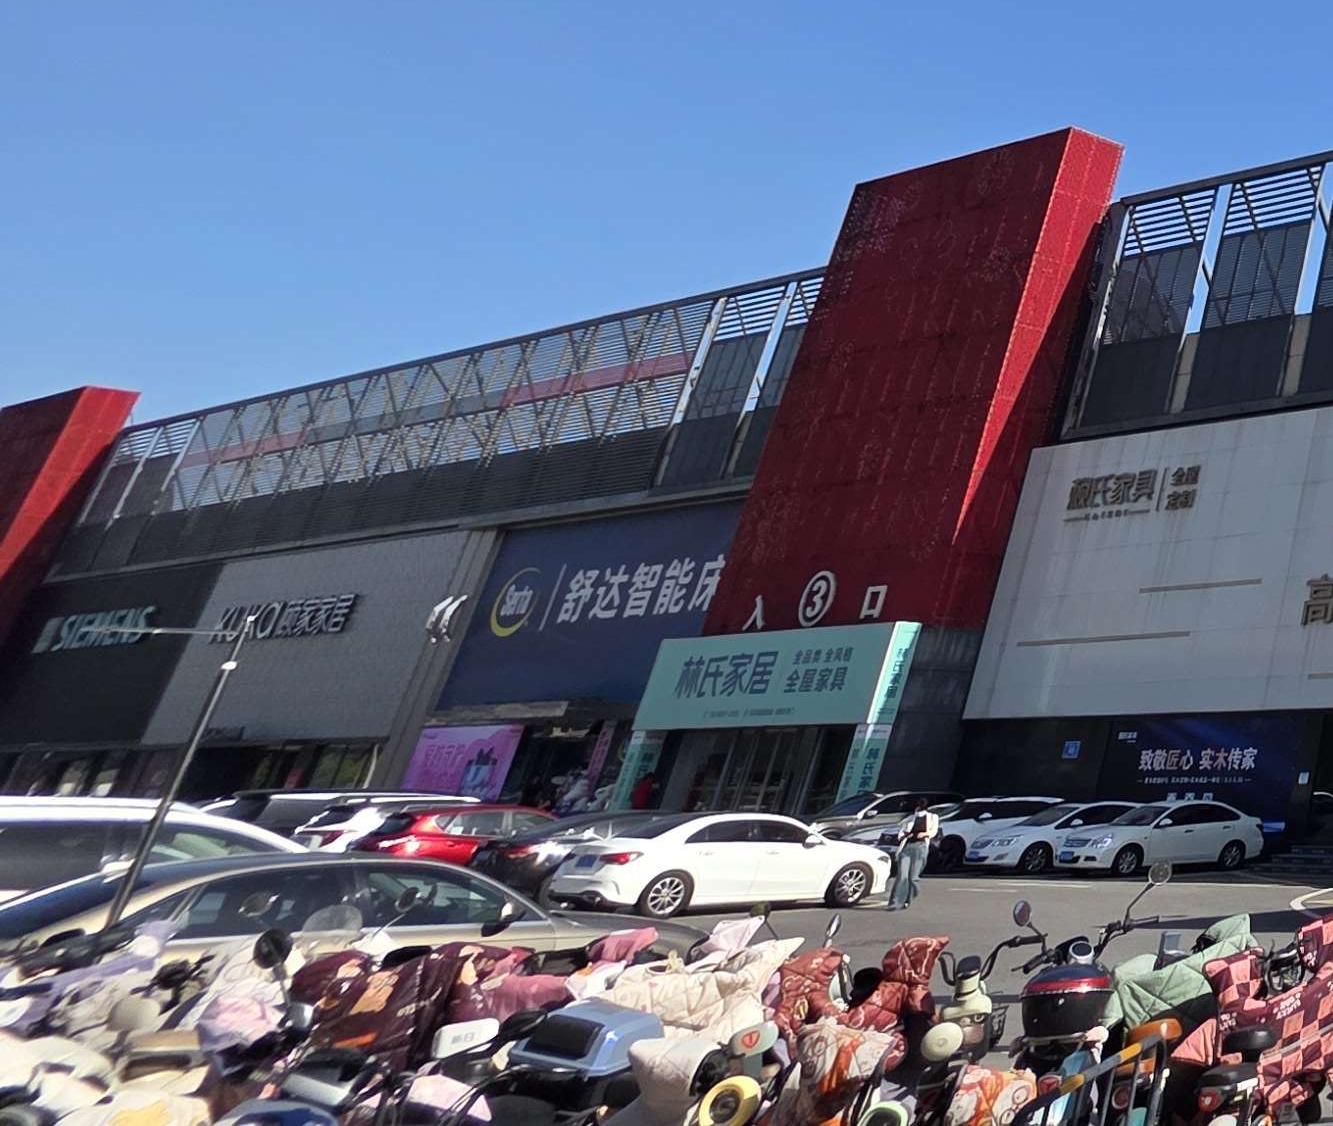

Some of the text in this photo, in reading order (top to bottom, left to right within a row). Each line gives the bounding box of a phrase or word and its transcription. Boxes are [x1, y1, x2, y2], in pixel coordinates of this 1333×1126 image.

[51, 605, 158, 652] SIEMENS
[674, 650, 780, 699] 林氏家居
[783, 666, 848, 694] 全屋家具
[1138, 747, 1258, 771] 致敬匠心 实木传家
